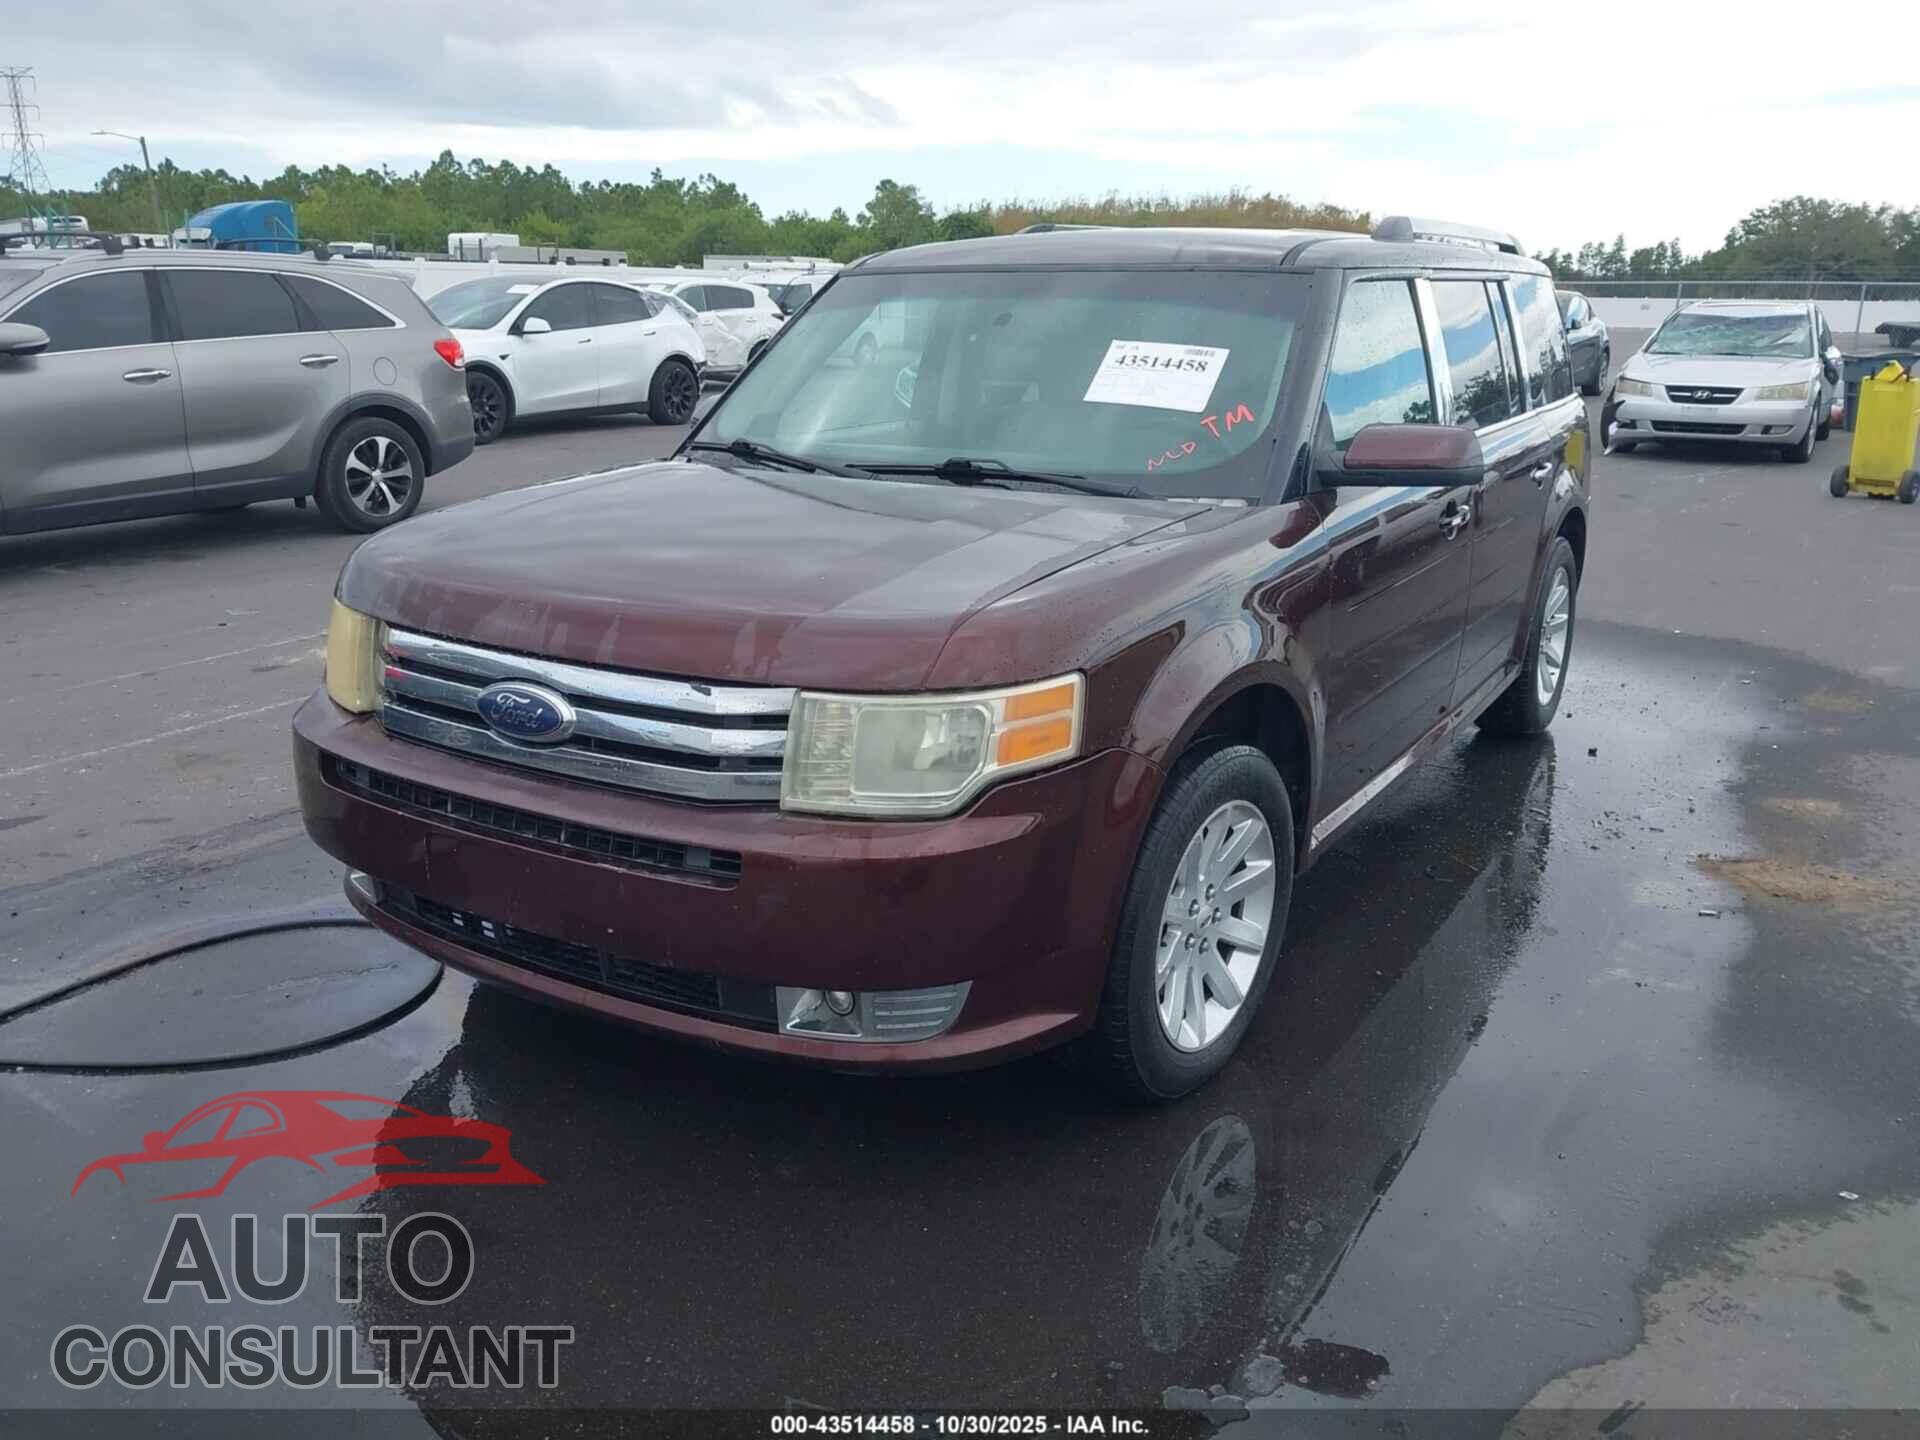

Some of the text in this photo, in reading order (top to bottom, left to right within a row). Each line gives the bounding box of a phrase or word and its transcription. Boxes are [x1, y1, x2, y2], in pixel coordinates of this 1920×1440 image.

[1115, 354, 1209, 373] 43514458
[1200, 403, 1255, 440] TM
[490, 692, 544, 729] Ford
